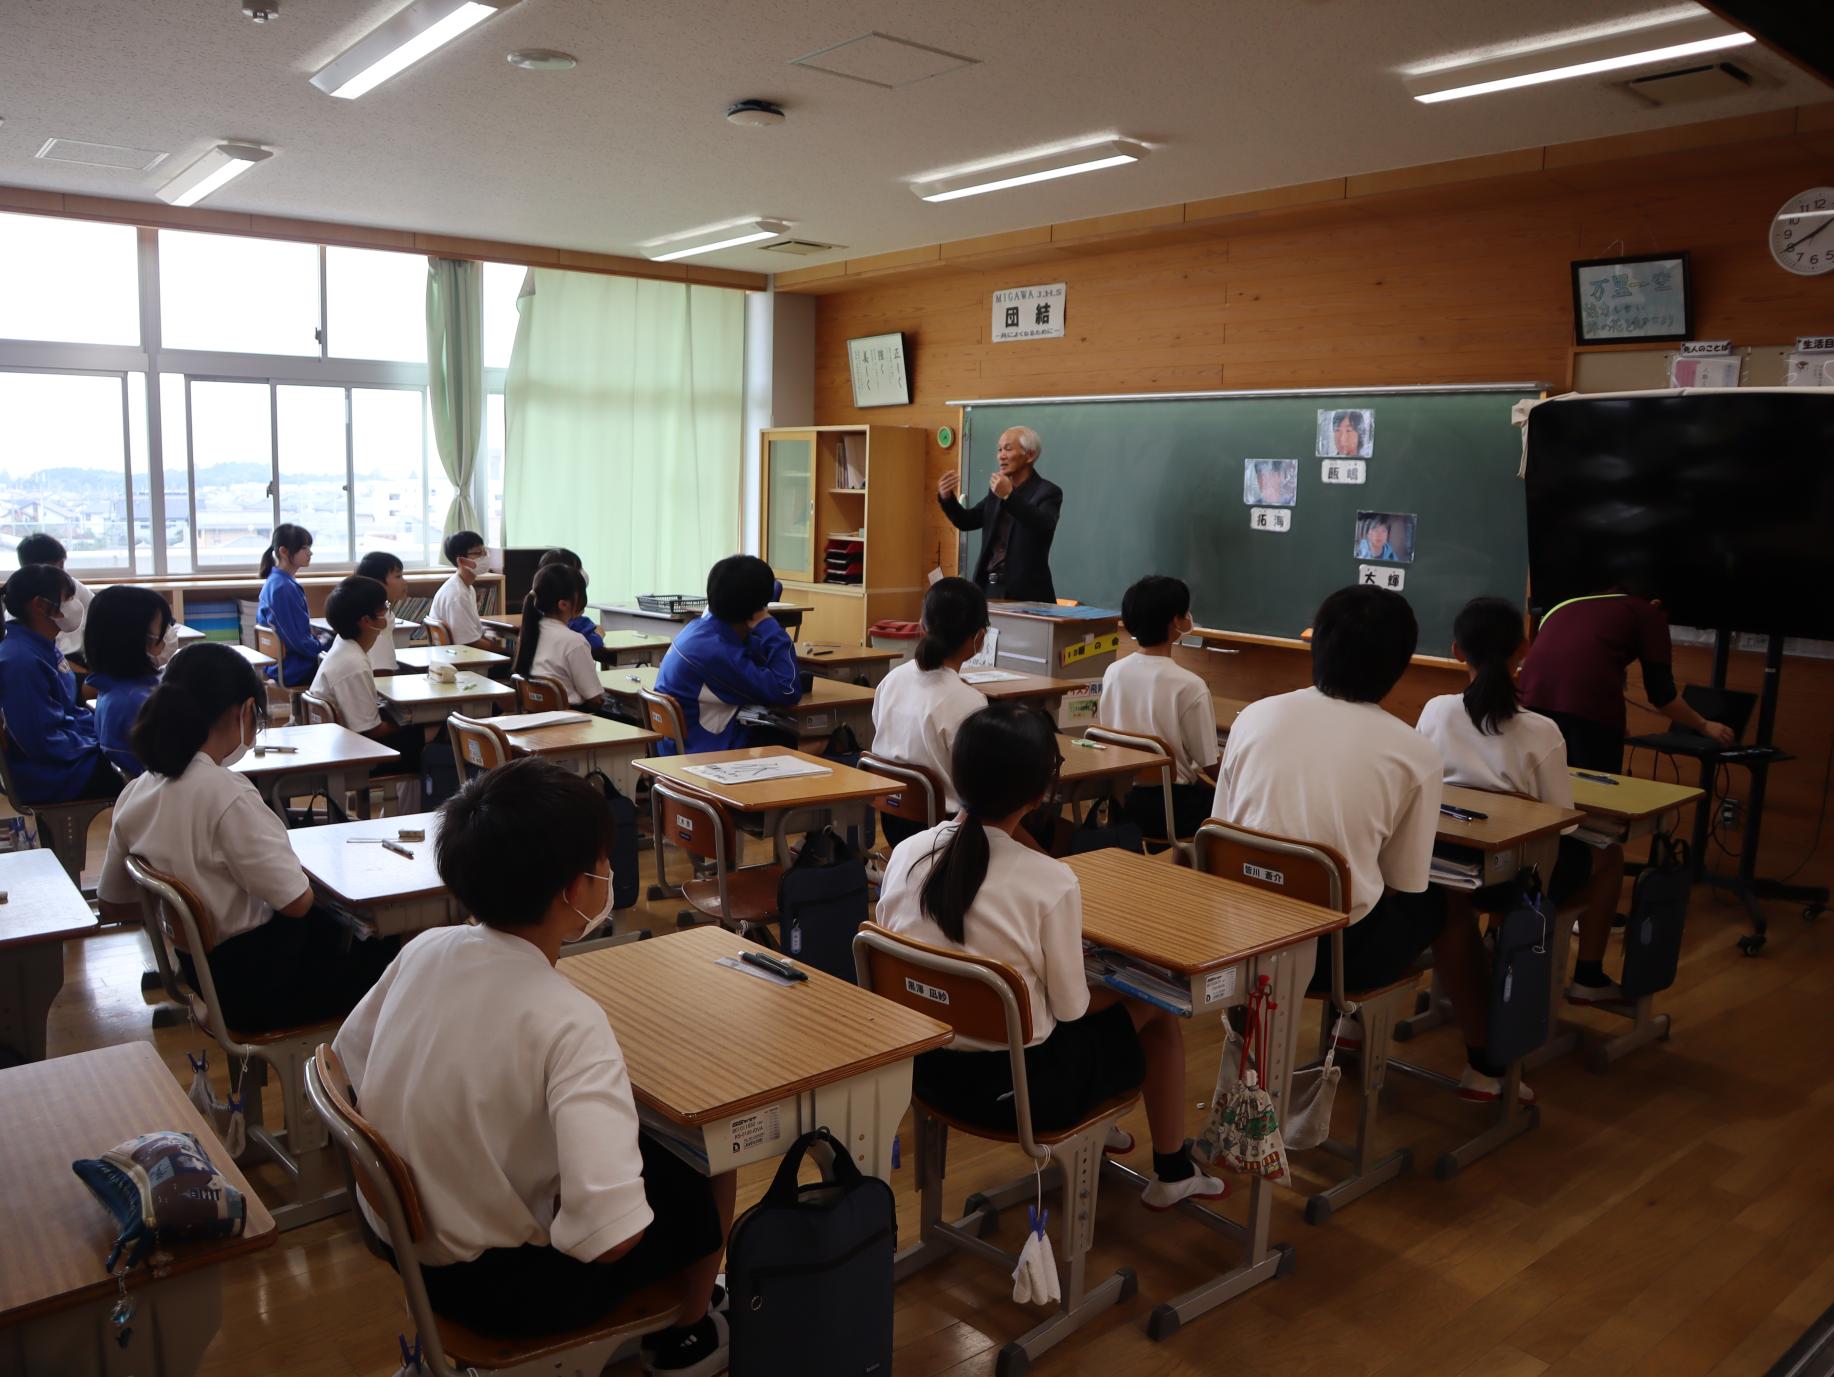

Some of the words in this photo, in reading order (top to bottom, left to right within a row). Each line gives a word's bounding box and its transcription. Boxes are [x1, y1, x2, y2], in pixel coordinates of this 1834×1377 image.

[1814, 198, 1826, 209] 12
[1784, 229, 1793, 240] 9
[1797, 252, 1804, 262] 7
[1810, 254, 1819, 264] 6
[1825, 250, 1834, 260] 5
[995, 290, 1034, 303] MIGAWA
[1005, 302, 1051, 328] 団結
